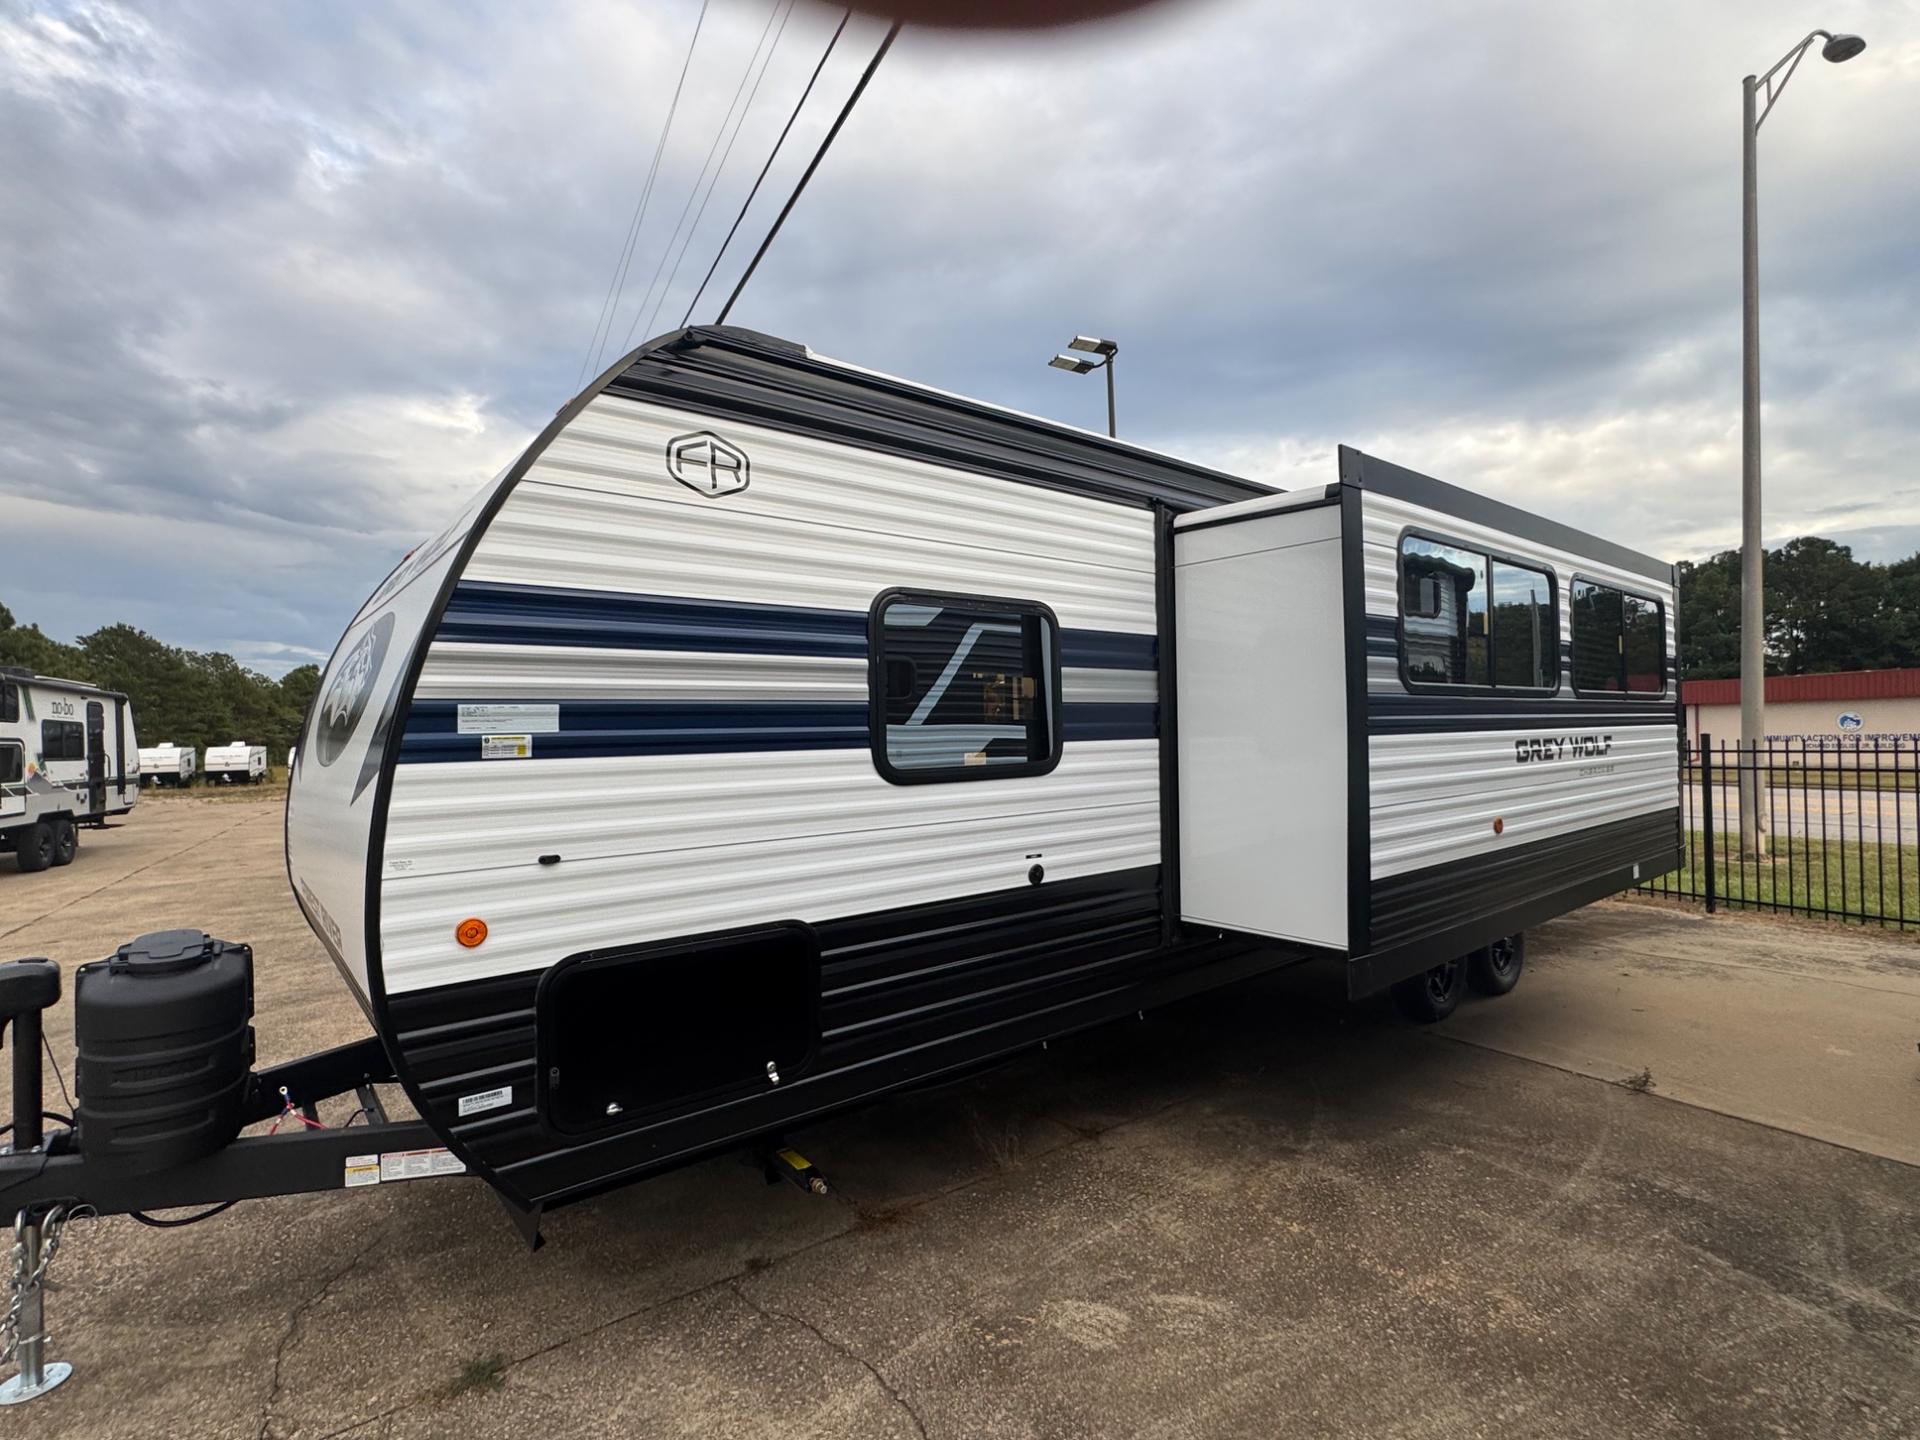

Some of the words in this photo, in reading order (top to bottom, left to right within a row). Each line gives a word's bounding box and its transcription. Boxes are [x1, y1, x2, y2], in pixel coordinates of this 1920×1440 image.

[1806, 734, 1841, 742] ACTION
[1842, 733, 1862, 742] FOR
[1514, 736, 1565, 763] GREY
[1569, 735, 1612, 759] WOLF
